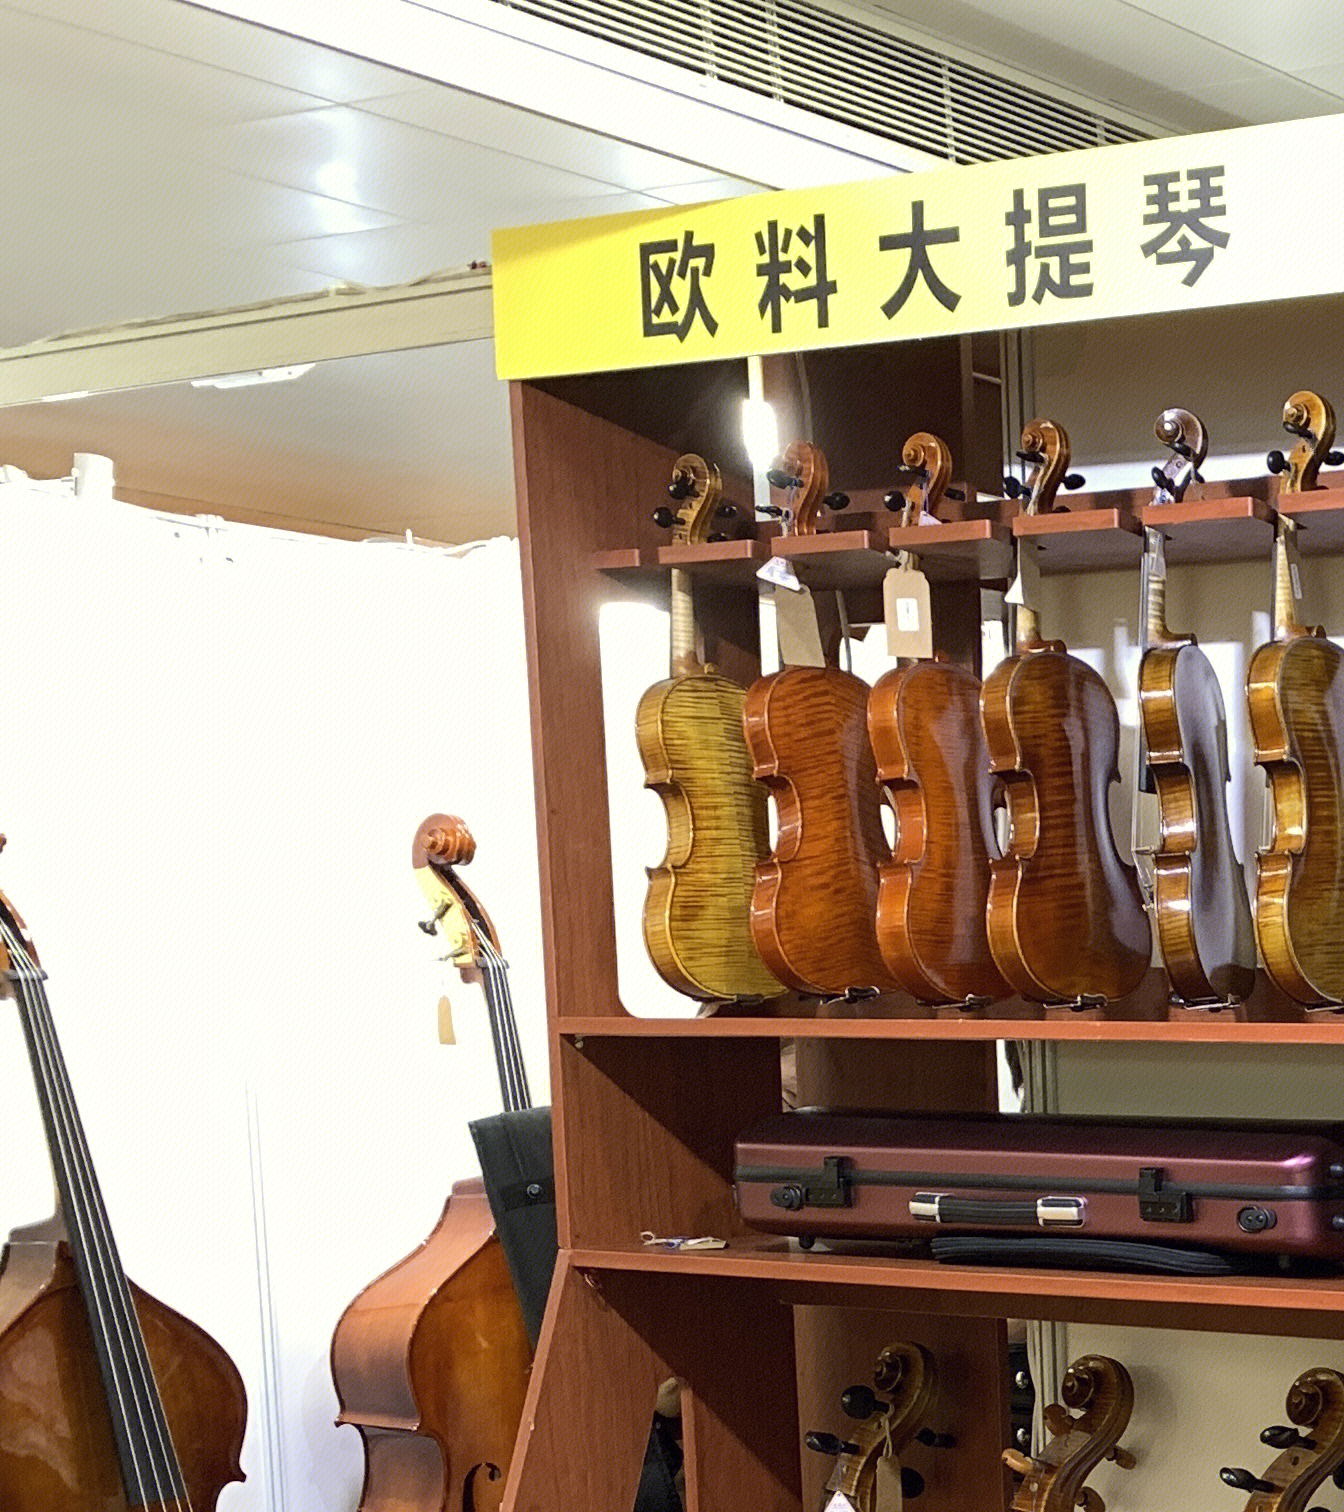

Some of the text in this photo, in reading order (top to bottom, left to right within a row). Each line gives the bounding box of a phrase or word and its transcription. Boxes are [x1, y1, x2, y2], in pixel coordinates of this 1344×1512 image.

[639, 165, 1231, 343] 欧料大提琴
